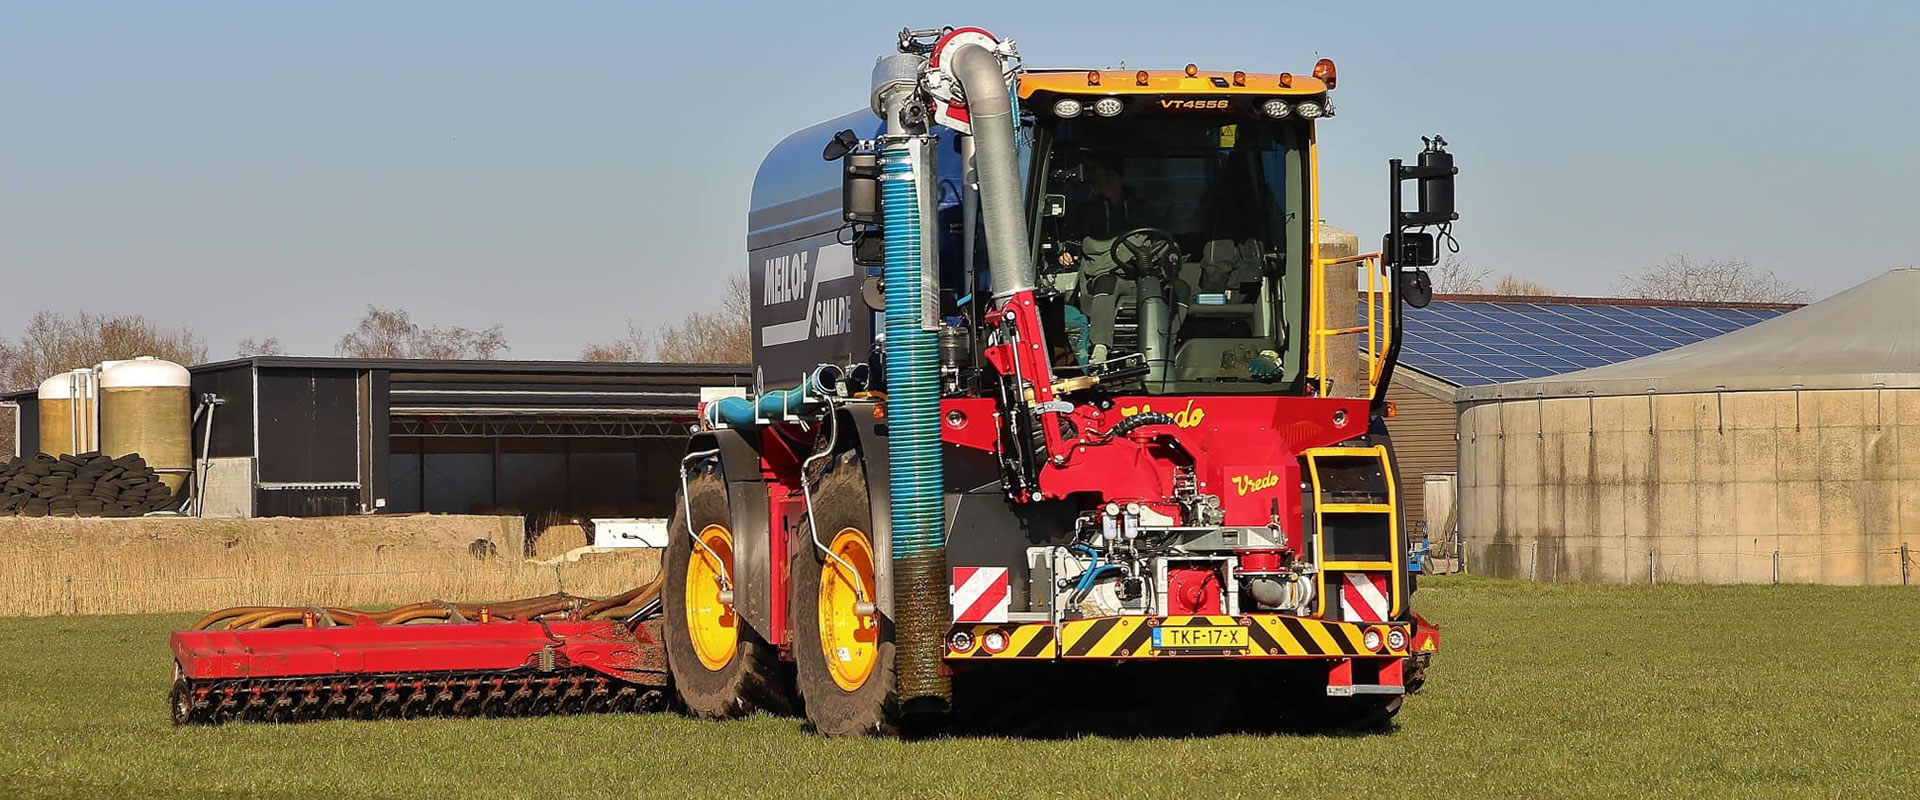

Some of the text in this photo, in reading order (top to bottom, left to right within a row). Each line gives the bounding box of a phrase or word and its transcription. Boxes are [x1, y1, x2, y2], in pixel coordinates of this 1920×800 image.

[1161, 99, 1229, 109] VT4556
[764, 251, 808, 306] MEILOF
[815, 295, 851, 338] SMILDE
[1231, 470, 1279, 496] Vredo
[1170, 630, 1239, 645] TKF-17-X
